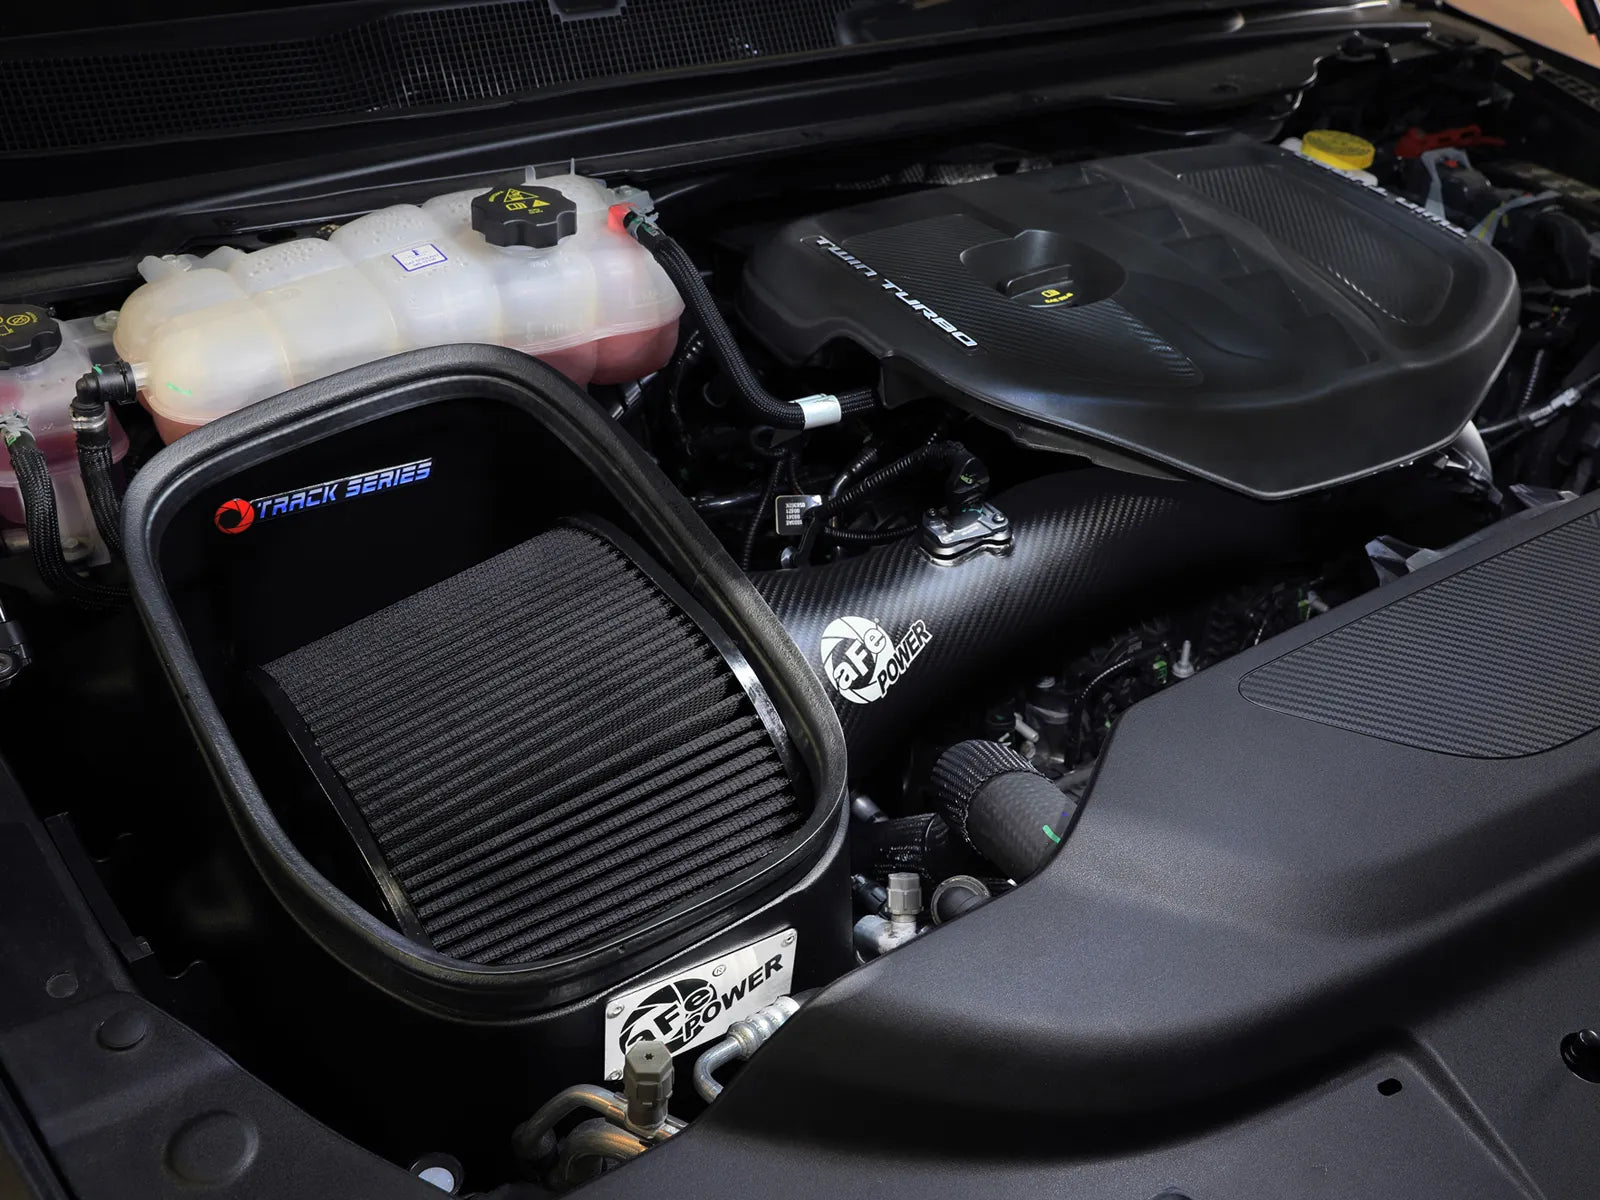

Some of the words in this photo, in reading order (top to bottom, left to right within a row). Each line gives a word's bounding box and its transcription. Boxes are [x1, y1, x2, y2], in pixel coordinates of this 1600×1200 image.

[816, 235, 878, 278] TWIN
[882, 278, 979, 348] TURBO
[257, 483, 338, 520] TRACK
[344, 460, 433, 499] SERIES
[832, 626, 888, 692] aFe
[876, 619, 933, 699] POWER
[683, 953, 784, 1040] POWER
